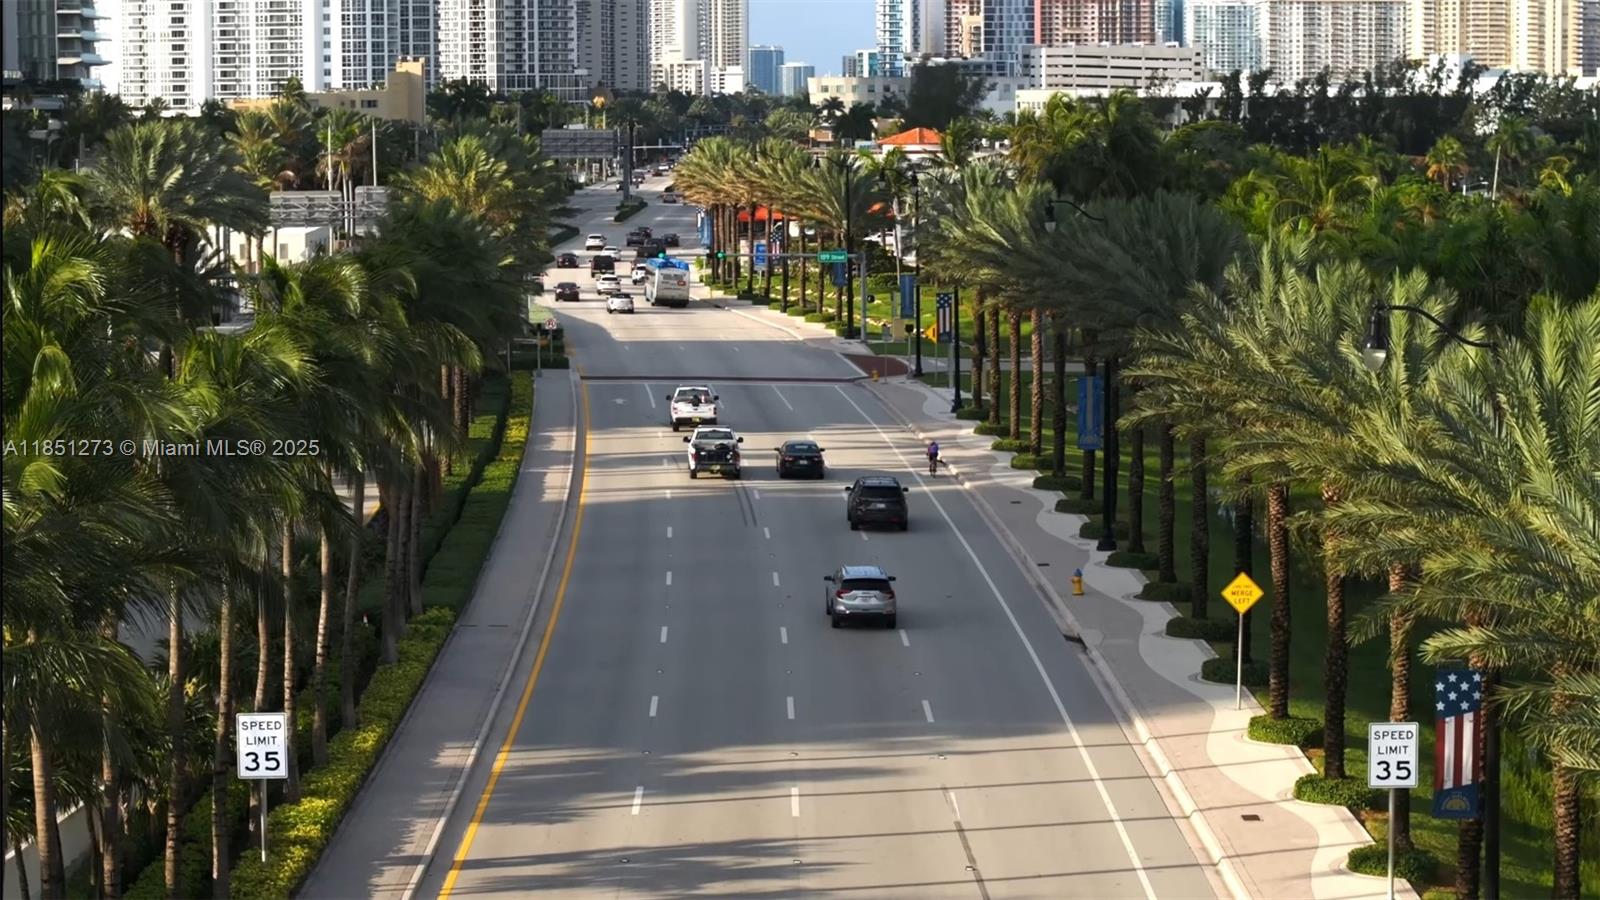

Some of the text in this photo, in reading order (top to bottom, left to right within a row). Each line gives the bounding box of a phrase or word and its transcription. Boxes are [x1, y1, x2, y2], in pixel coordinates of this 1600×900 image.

[241, 721, 282, 731] SPEED
[1374, 730, 1414, 740] SPEED
[246, 736, 277, 745] LIMIT
[1377, 745, 1408, 755] LIMIT
[245, 751, 280, 771] 35
[1376, 760, 1411, 780] 35
